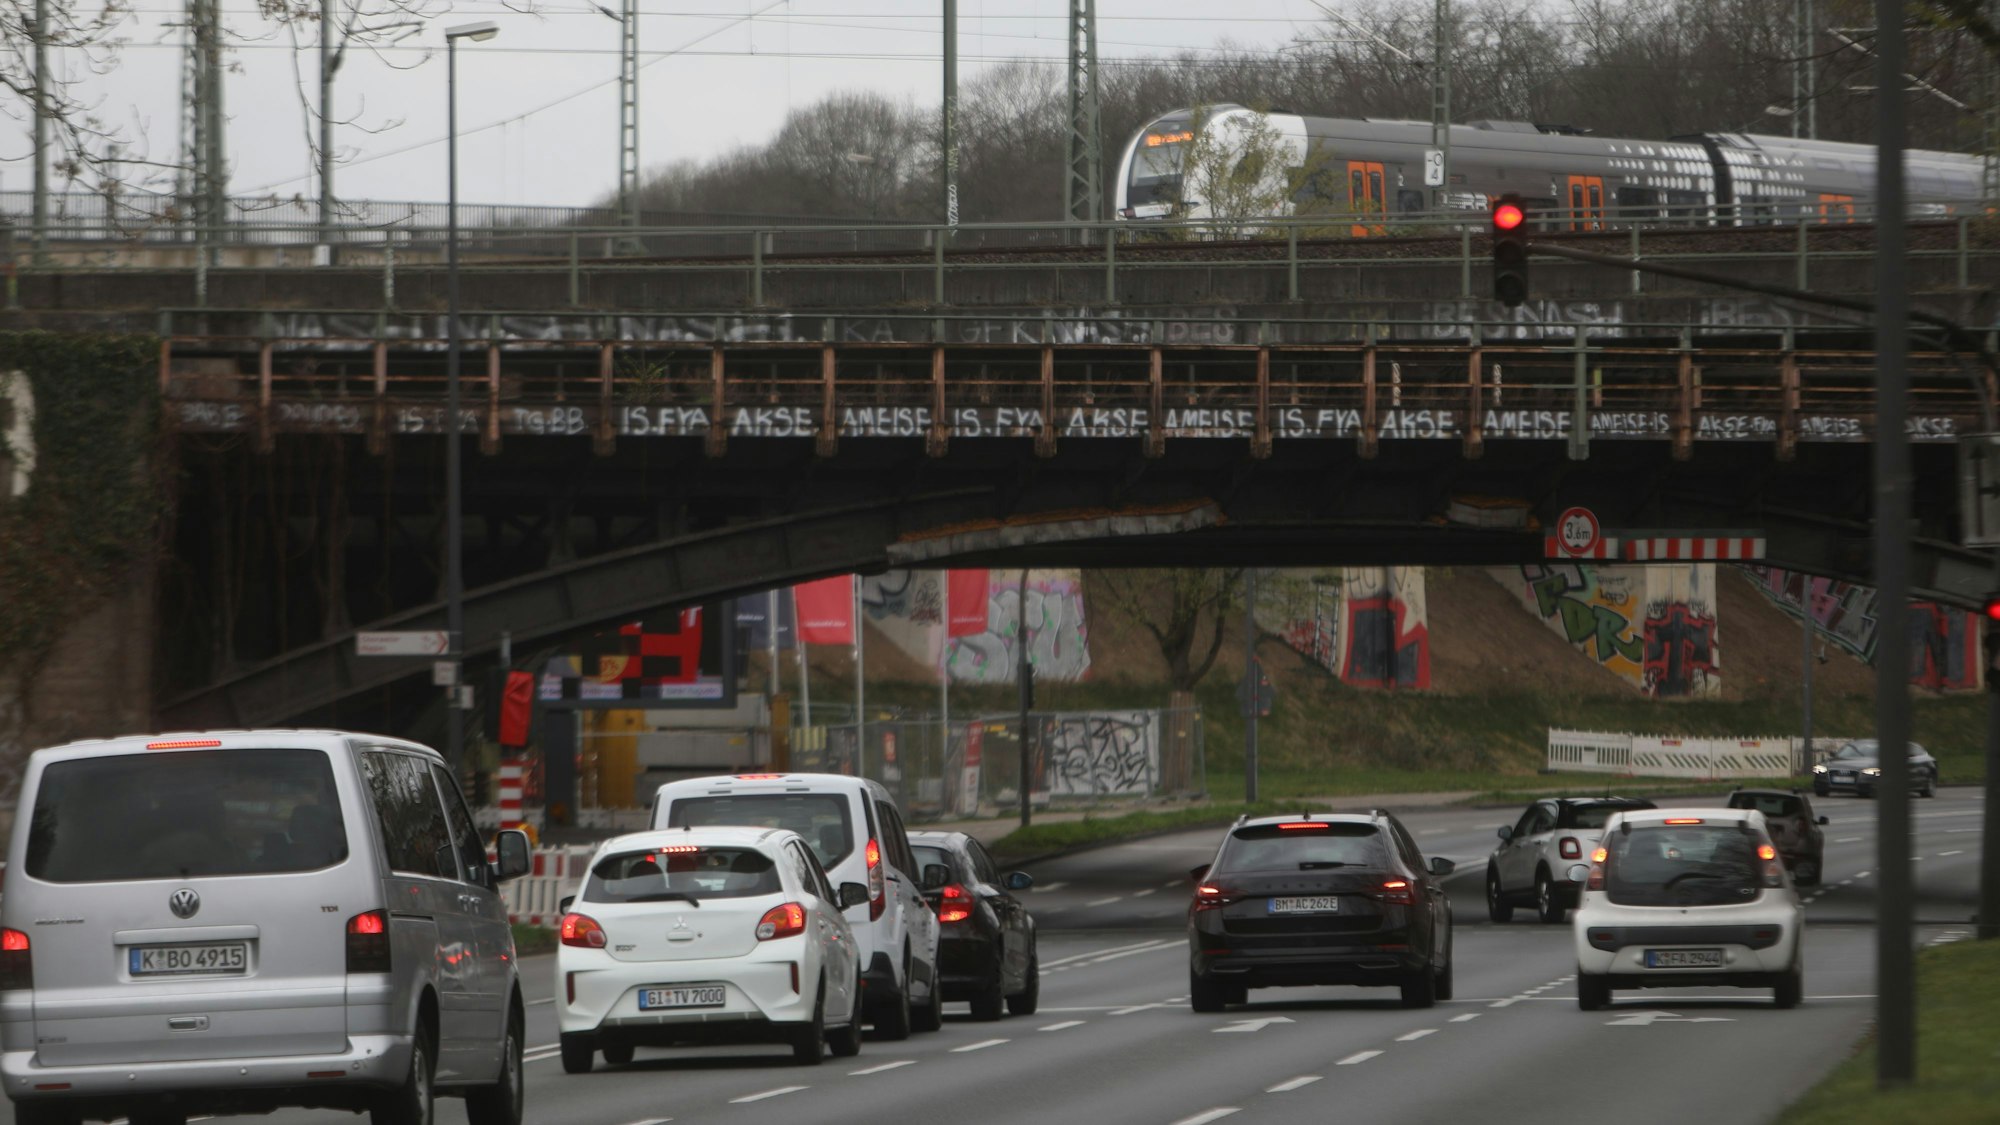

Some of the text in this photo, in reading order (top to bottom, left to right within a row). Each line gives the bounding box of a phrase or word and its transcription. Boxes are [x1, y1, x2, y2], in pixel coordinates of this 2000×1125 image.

[1275, 897, 1337, 911] BM AC 262E
[142, 948, 242, 970] K BO 4915
[1671, 952, 1687, 965] FA
[648, 988, 724, 1005] GI TV 7000
